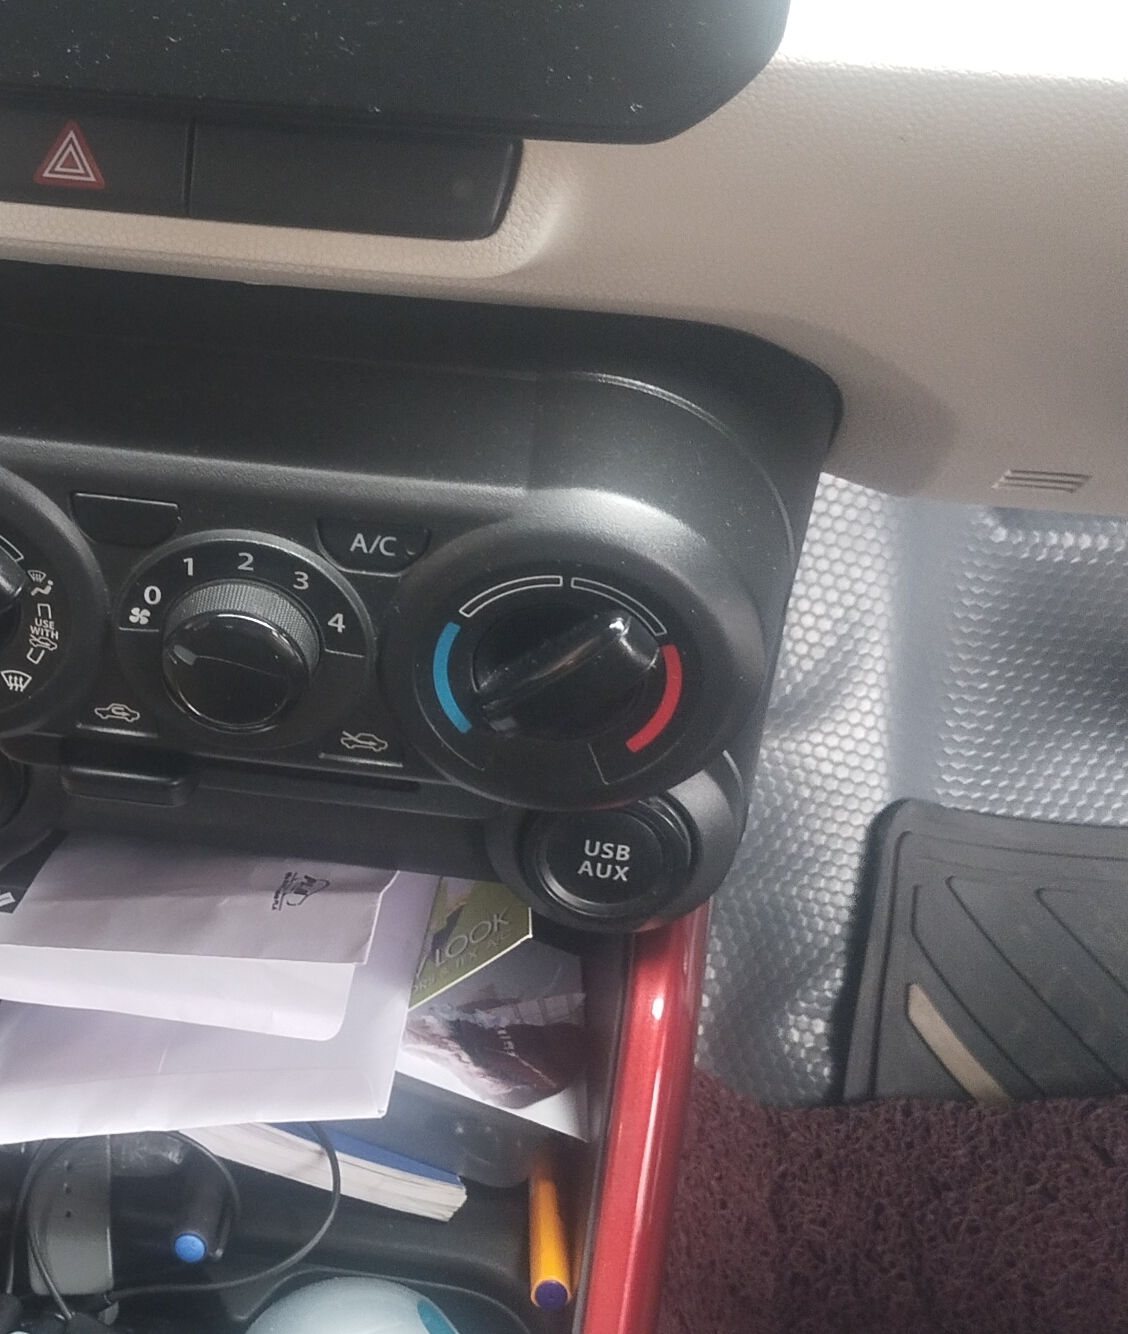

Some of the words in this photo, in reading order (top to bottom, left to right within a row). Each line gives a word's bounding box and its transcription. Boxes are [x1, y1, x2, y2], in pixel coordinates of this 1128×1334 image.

[349, 532, 397, 557] A/C
[183, 557, 194, 576] 1
[237, 552, 254, 571] 2
[292, 570, 309, 590] 3
[143, 585, 162, 605] 0
[30, 625, 59, 640] WITH
[35, 617, 54, 629] USE
[327, 612, 346, 633] 4
[584, 839, 631, 861] USB
[577, 860, 630, 882] AUX
[434, 906, 510, 968] LOOK
